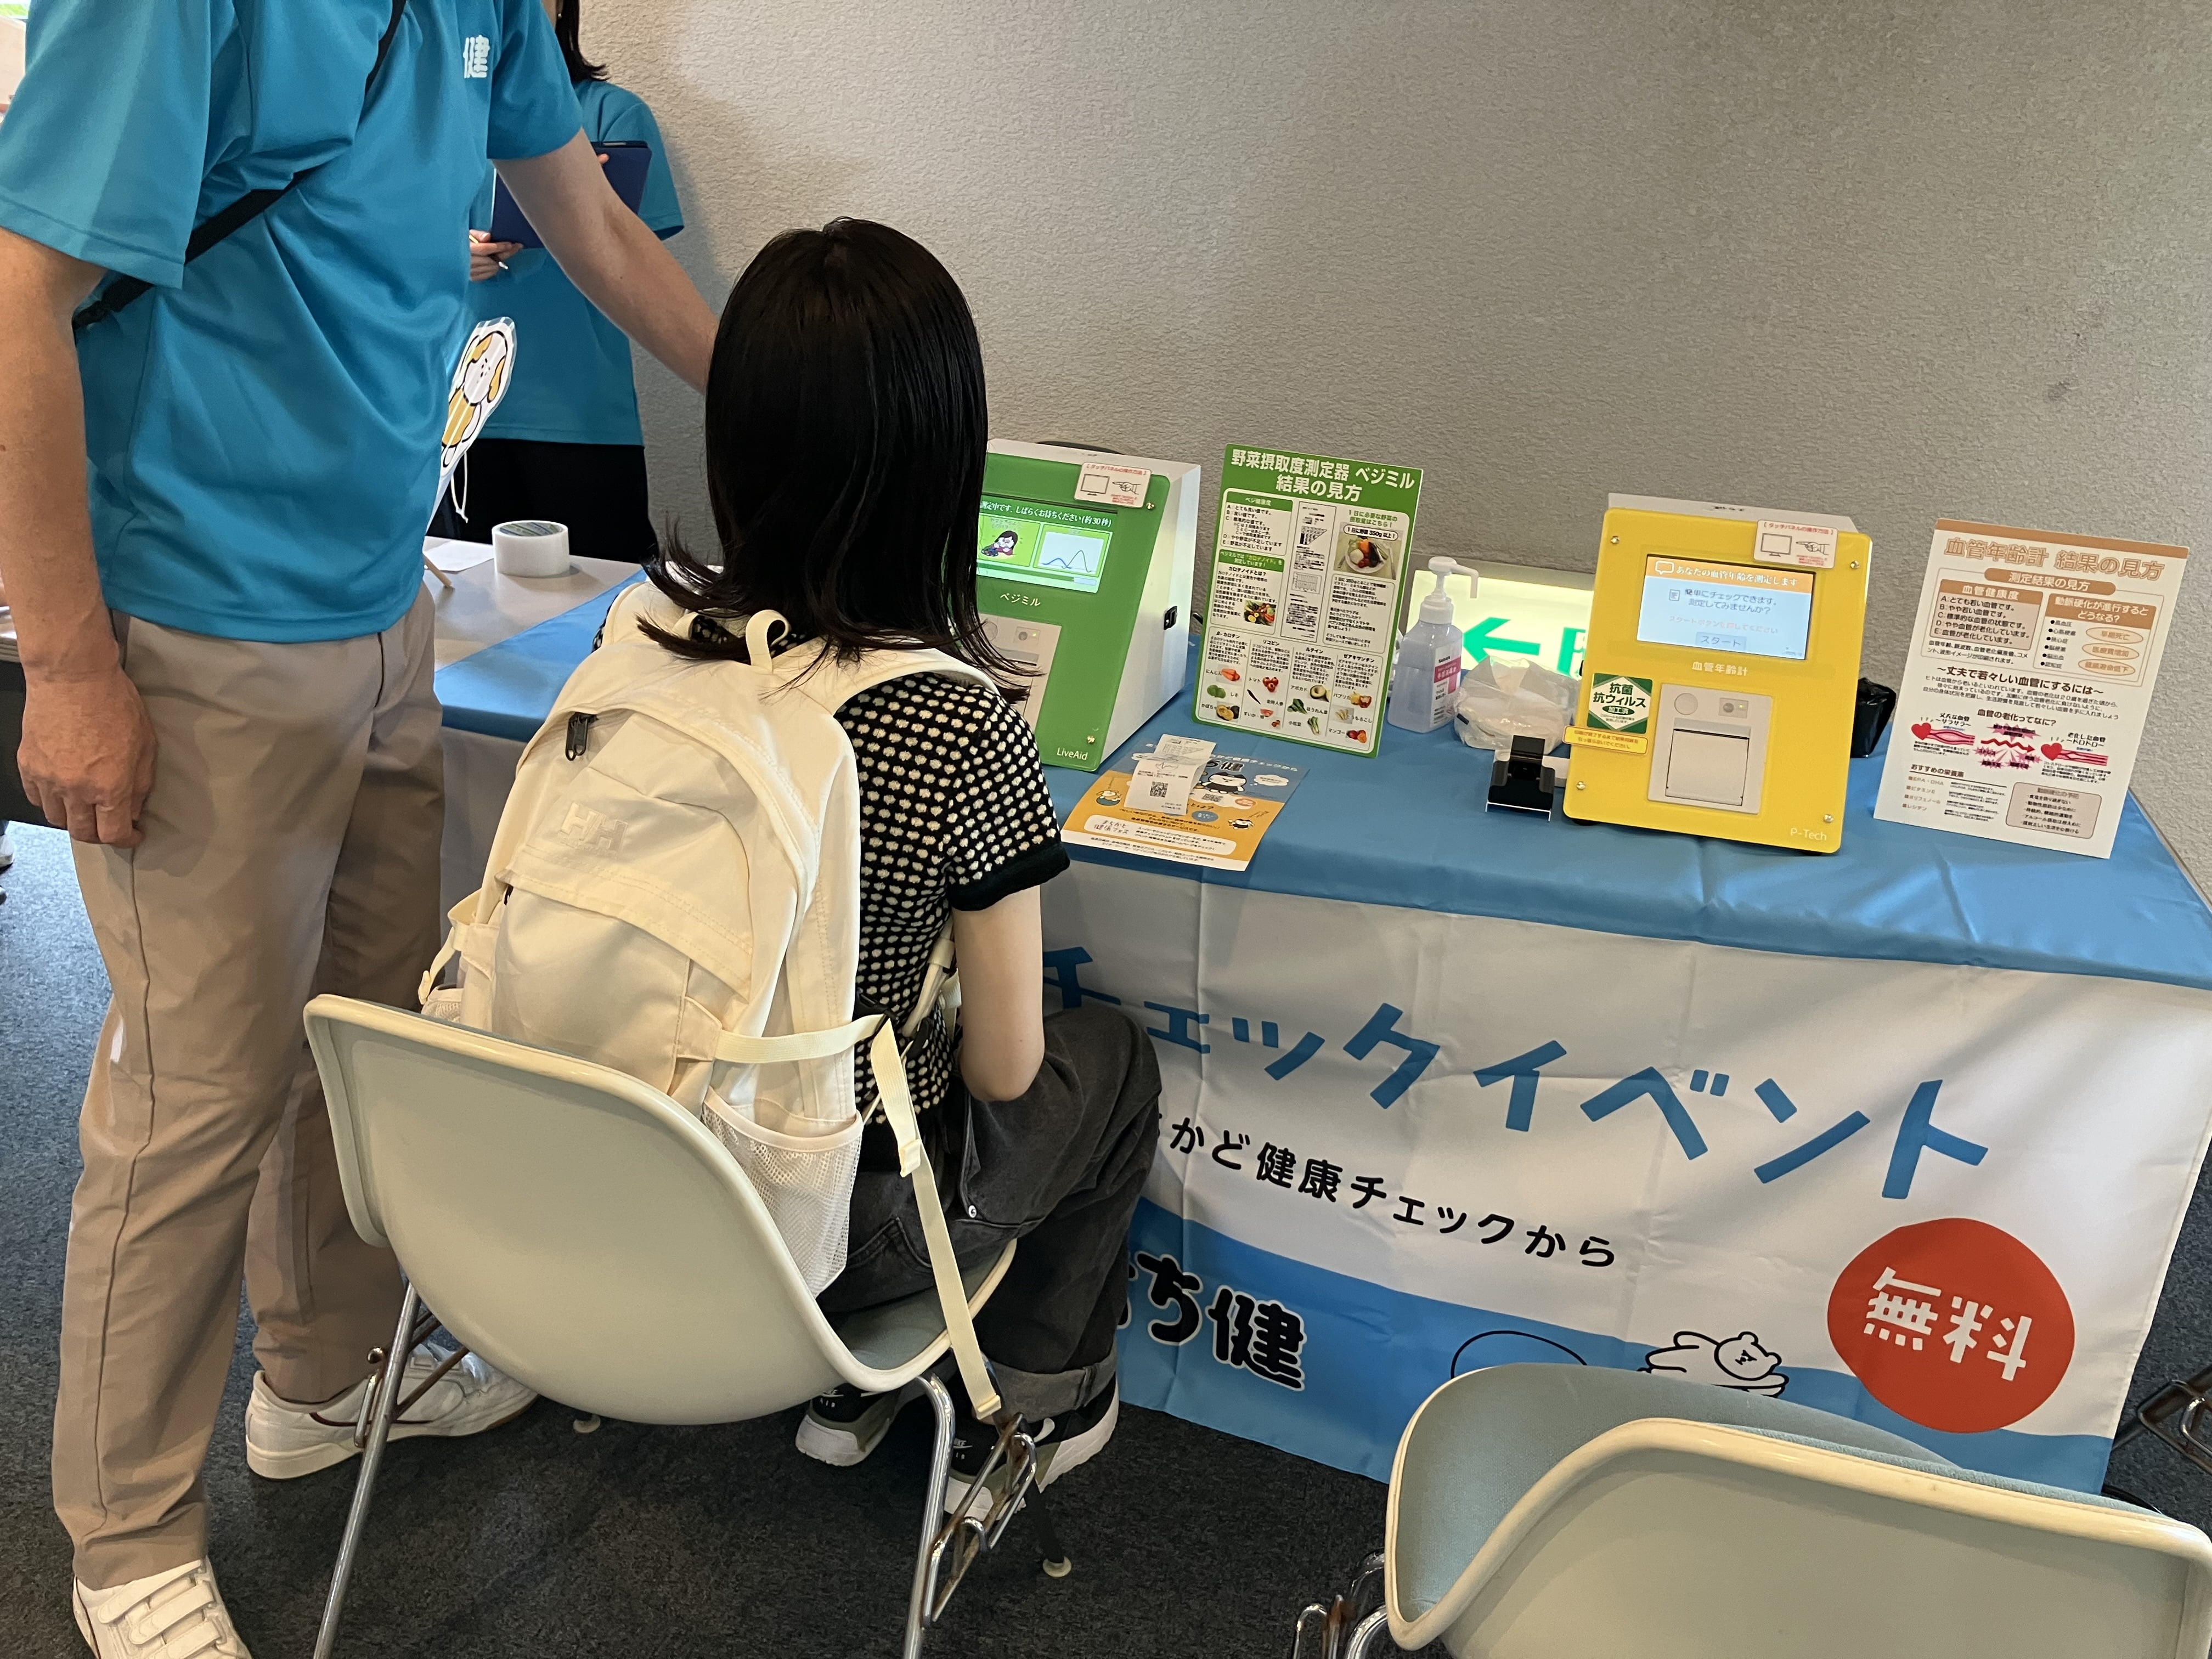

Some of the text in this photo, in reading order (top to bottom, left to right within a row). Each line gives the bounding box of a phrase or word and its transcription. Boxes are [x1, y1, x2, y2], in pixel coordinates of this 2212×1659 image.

[462, 35, 490, 78] 健
[1231, 449, 1415, 490] 野菜摂取度測定器 ベジミル
[1276, 475, 1362, 503] 結果の見方
[1944, 537, 2165, 582] 血管年齢計 結果の見方
[1676, 566, 1798, 587] あなたの血管年齢を測定します
[2008, 572, 2091, 592] 測定結果の見方
[1000, 592, 1041, 607] ベジミル
[1962, 585, 2019, 601] 血管健康度
[2055, 596, 2149, 616] 動脈硬化が進行すると
[2078, 610, 2120, 624] どうなる？
[1700, 635, 1742, 648] スタート
[1691, 661, 1749, 677] 血管年齢計
[1609, 682, 1634, 696] 抗菌
[1593, 691, 1647, 708] 抗ウィルス
[1977, 708, 2057, 727] 血管の老化ってなに？
[1057, 747, 1088, 761] LiveAid
[1790, 827, 1827, 841] P-Tech
[1043, 946, 1989, 1199] チェックイベント
[1159, 1117, 1616, 1268] かど健康チェックから
[1117, 1251, 1307, 1391] ち健
[1863, 1267, 2032, 1382] 無料
